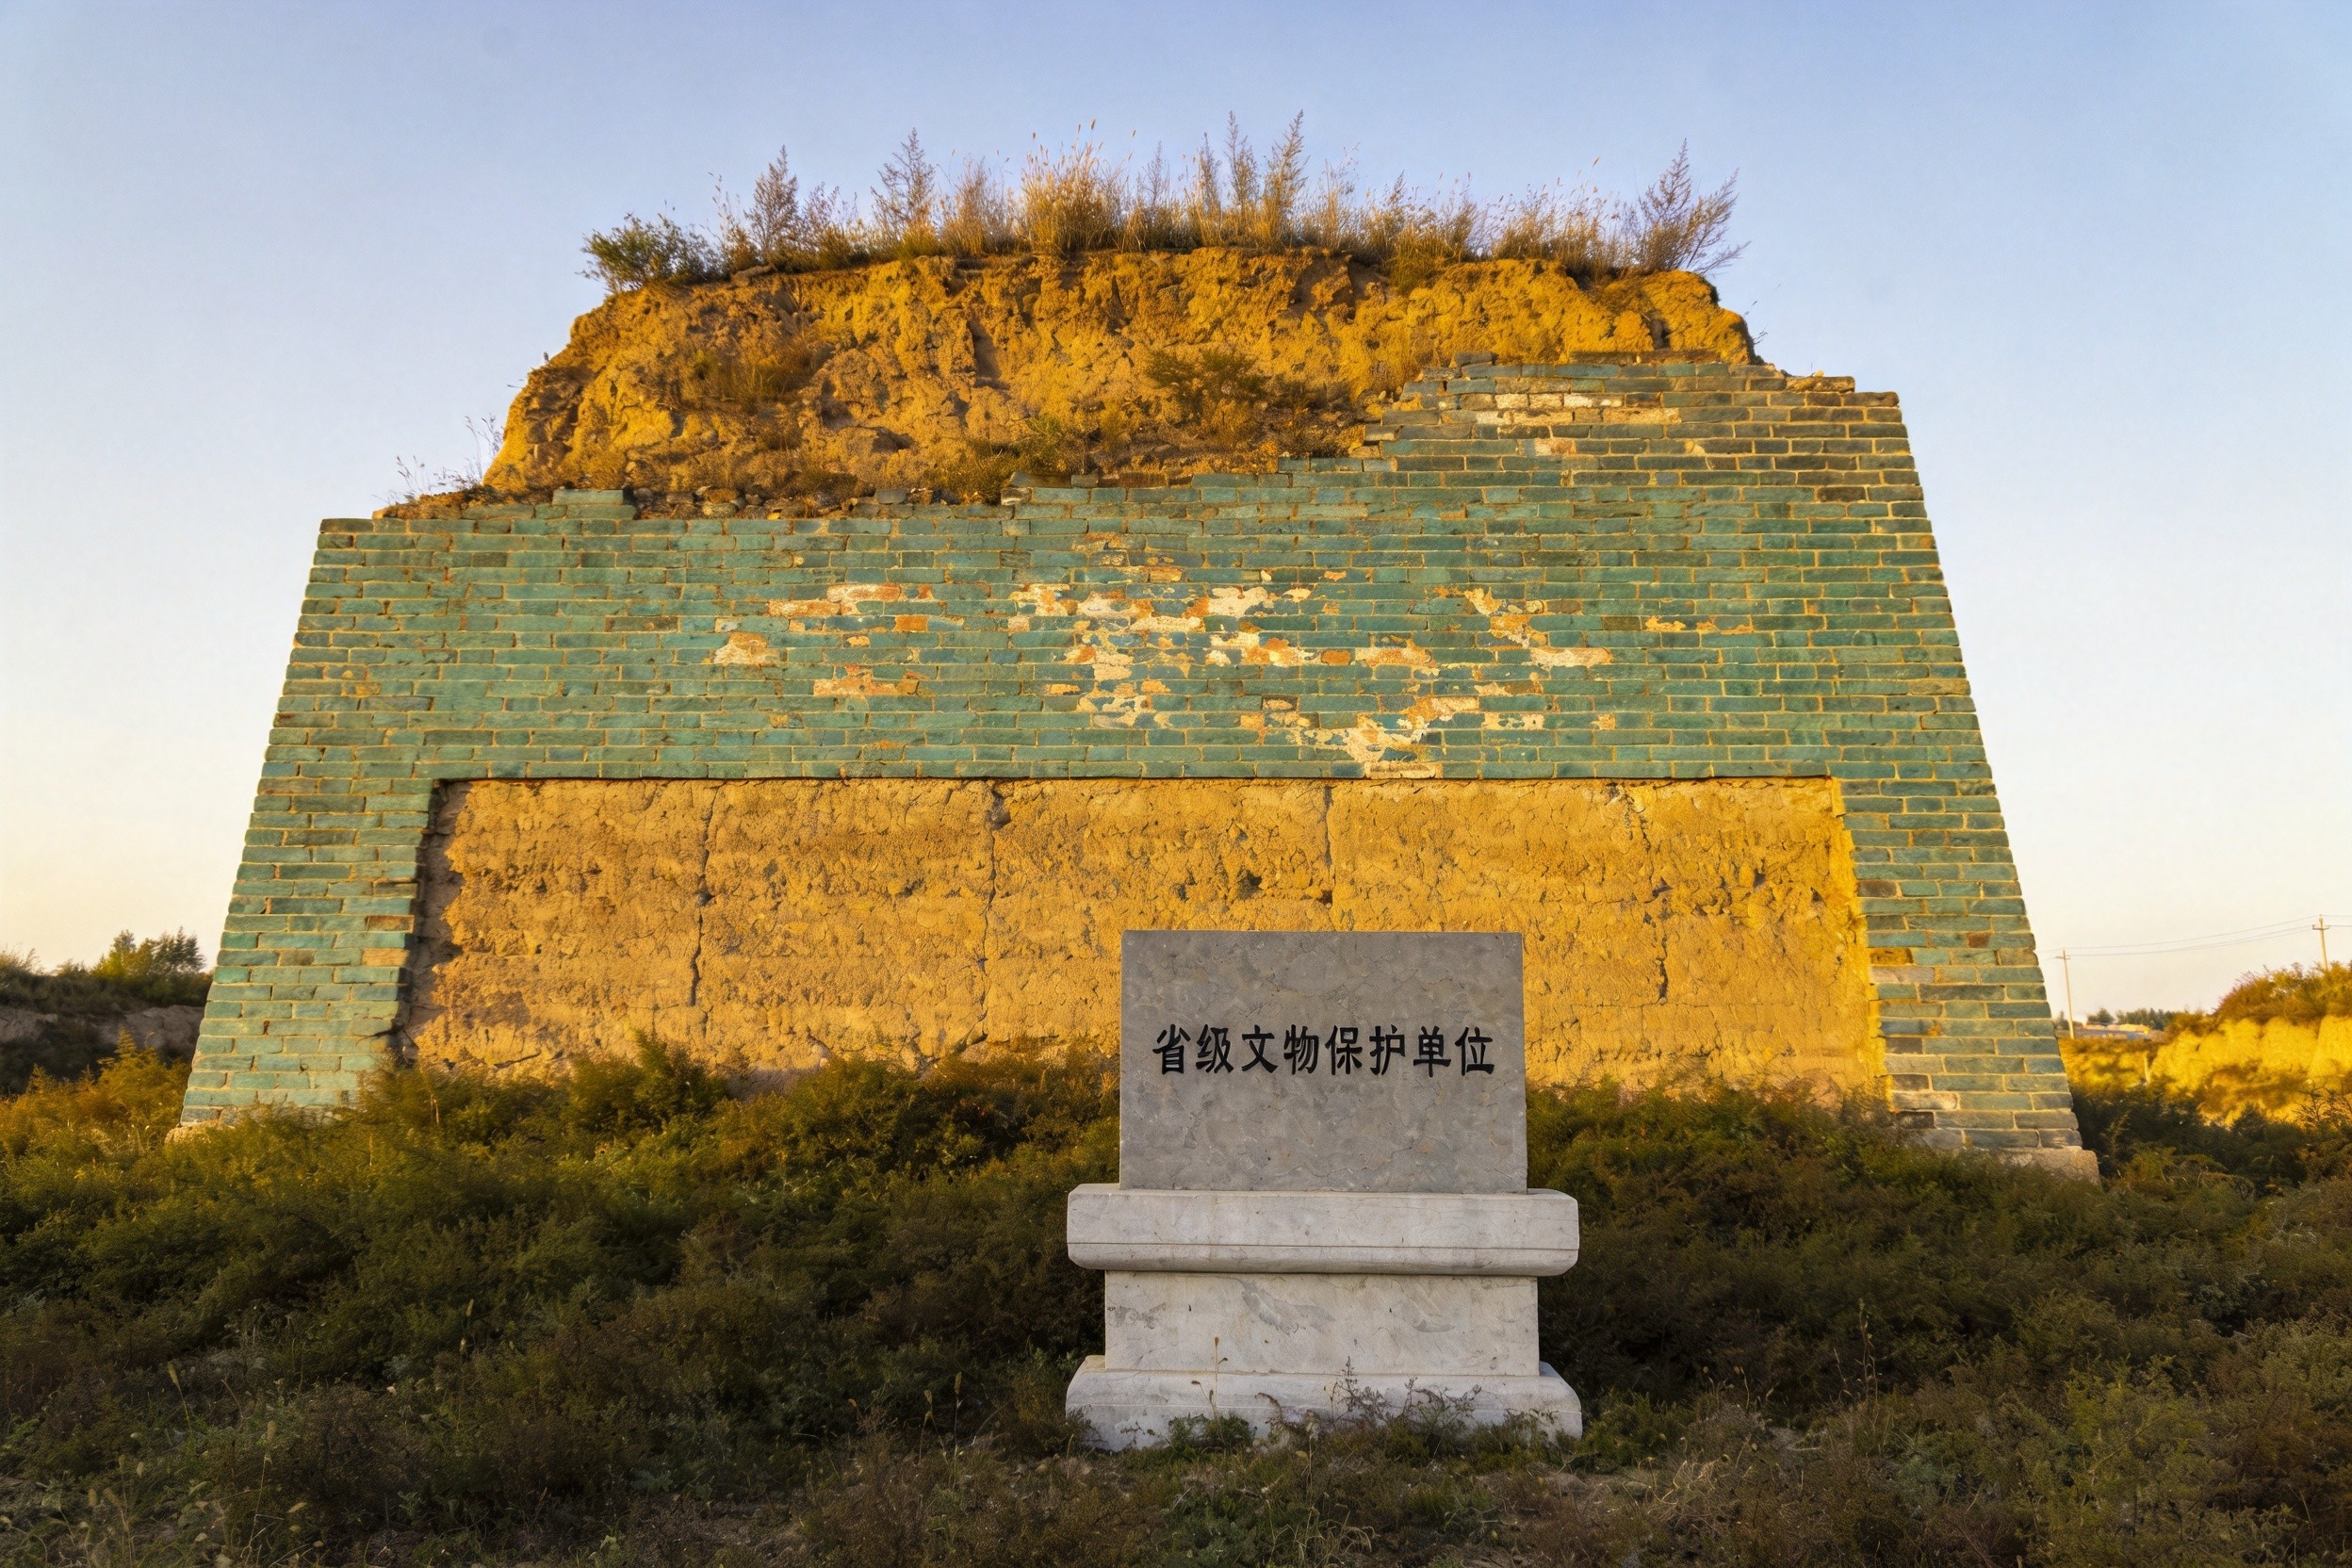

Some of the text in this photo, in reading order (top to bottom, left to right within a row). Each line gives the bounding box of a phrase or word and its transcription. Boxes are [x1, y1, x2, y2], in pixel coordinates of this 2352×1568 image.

[1152, 1023, 1495, 1078] 省级文物保护单位
